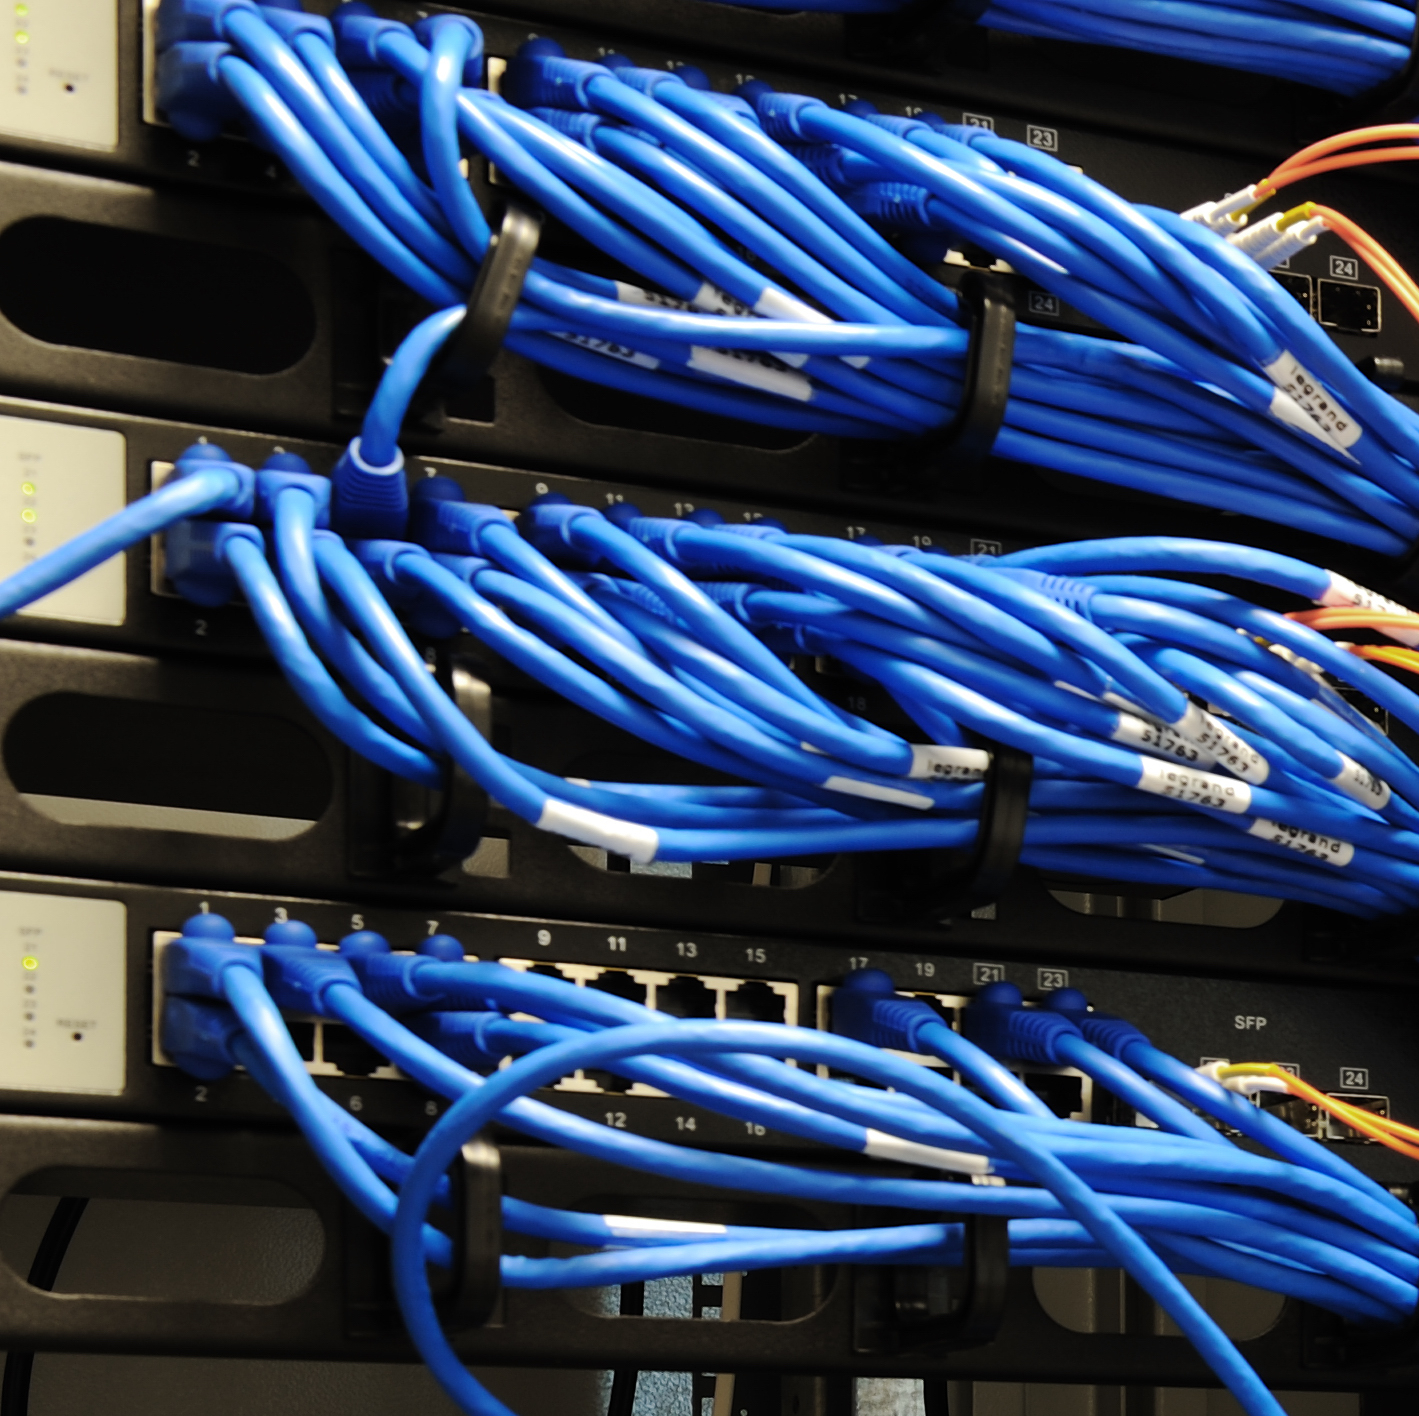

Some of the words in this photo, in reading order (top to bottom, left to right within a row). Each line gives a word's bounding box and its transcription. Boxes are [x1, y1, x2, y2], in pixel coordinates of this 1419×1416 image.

[1033, 131, 1052, 146] 23
[1335, 261, 1353, 276] 24
[1289, 364, 1348, 432] legrand
[1141, 730, 1199, 763] 51763
[1197, 731, 1249, 775] 51763
[1159, 770, 1235, 797] legrand
[608, 936, 626, 951] 11
[677, 943, 697, 958] 13
[746, 949, 766, 963] 15
[915, 962, 935, 977] 19
[981, 968, 999, 982] 21
[1044, 972, 1063, 987] 23
[1234, 1015, 1267, 1031] SFP
[1346, 1071, 1363, 1085] 24
[606, 1112, 626, 1128] 12
[676, 1116, 696, 1131] 14
